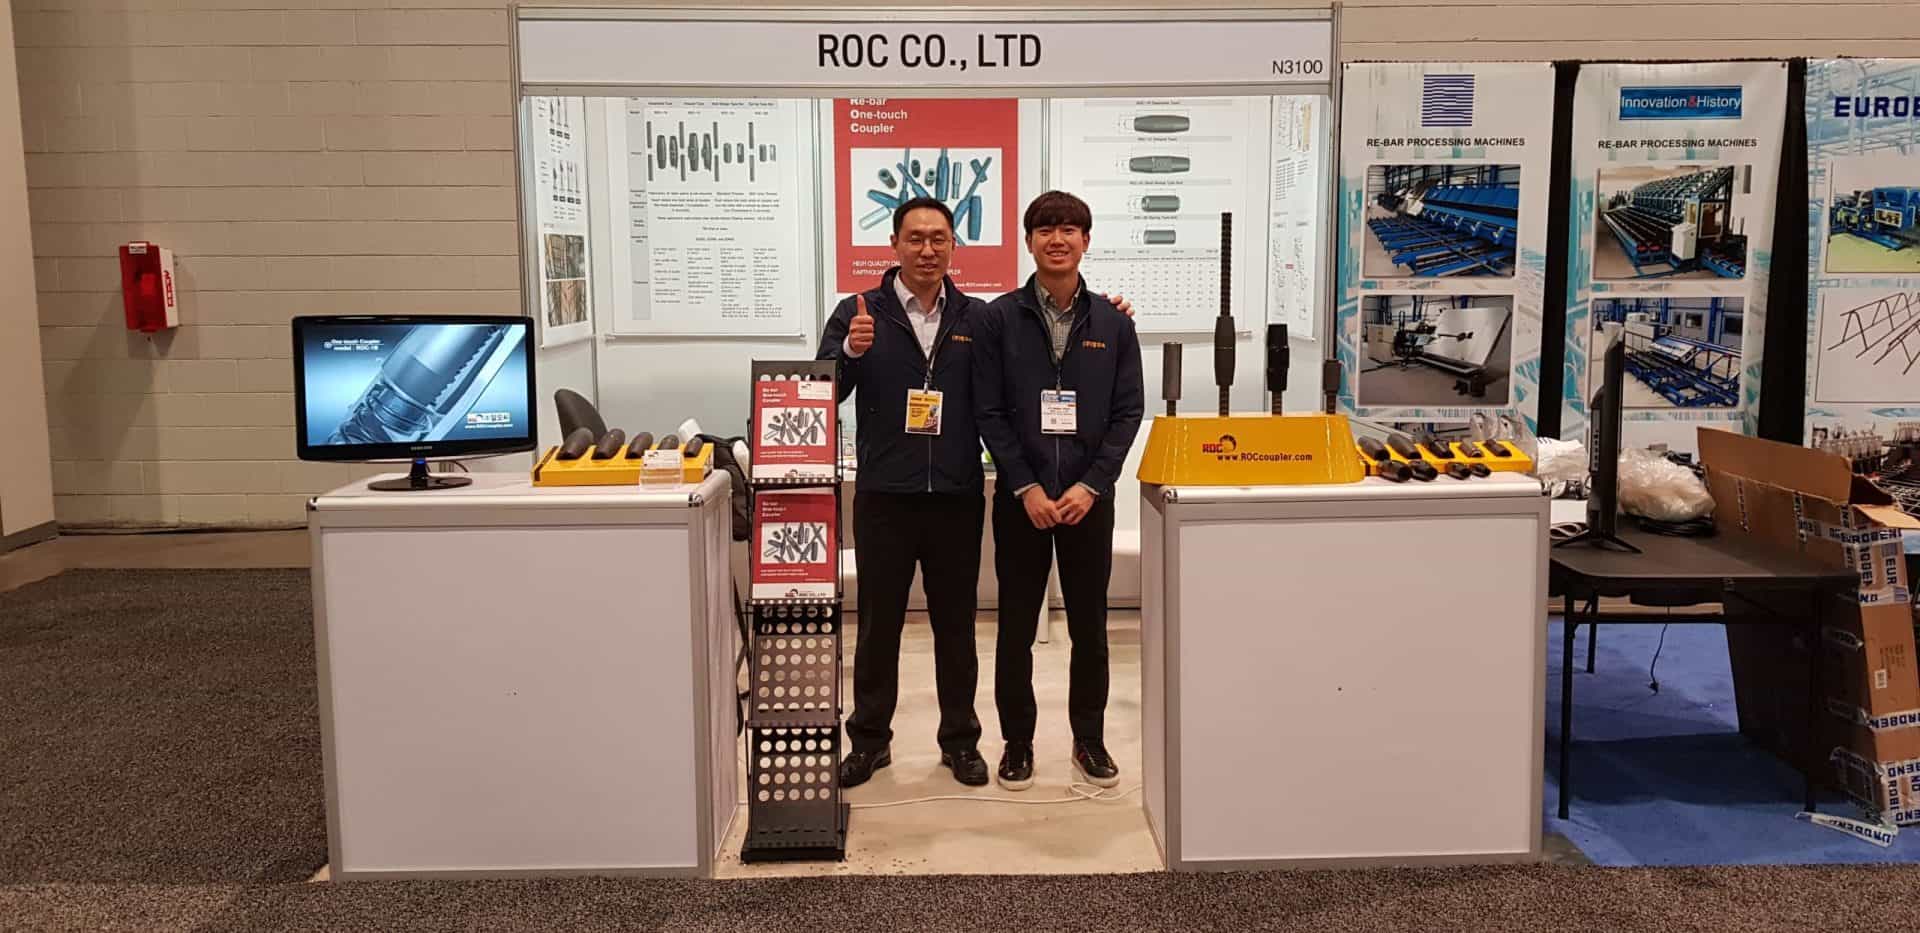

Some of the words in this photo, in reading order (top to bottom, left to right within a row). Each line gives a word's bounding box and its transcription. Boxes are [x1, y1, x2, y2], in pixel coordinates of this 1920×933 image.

[818, 34, 889, 68] ROC
[900, 34, 967, 72] CO.,
[978, 34, 1042, 68] LTD
[1272, 60, 1323, 75] N3100
[850, 108, 908, 120] One-touch
[850, 122, 895, 135] Coupler
[1366, 138, 1405, 147] RE-BAR
[1406, 138, 1472, 147] PROCESSING
[1473, 137, 1525, 147] MACHINES
[1597, 139, 1638, 149] RE-BAR
[1640, 138, 1705, 148] PROCESSING
[1707, 138, 1757, 148] MACHINES
[1203, 443, 1223, 453] ROC
